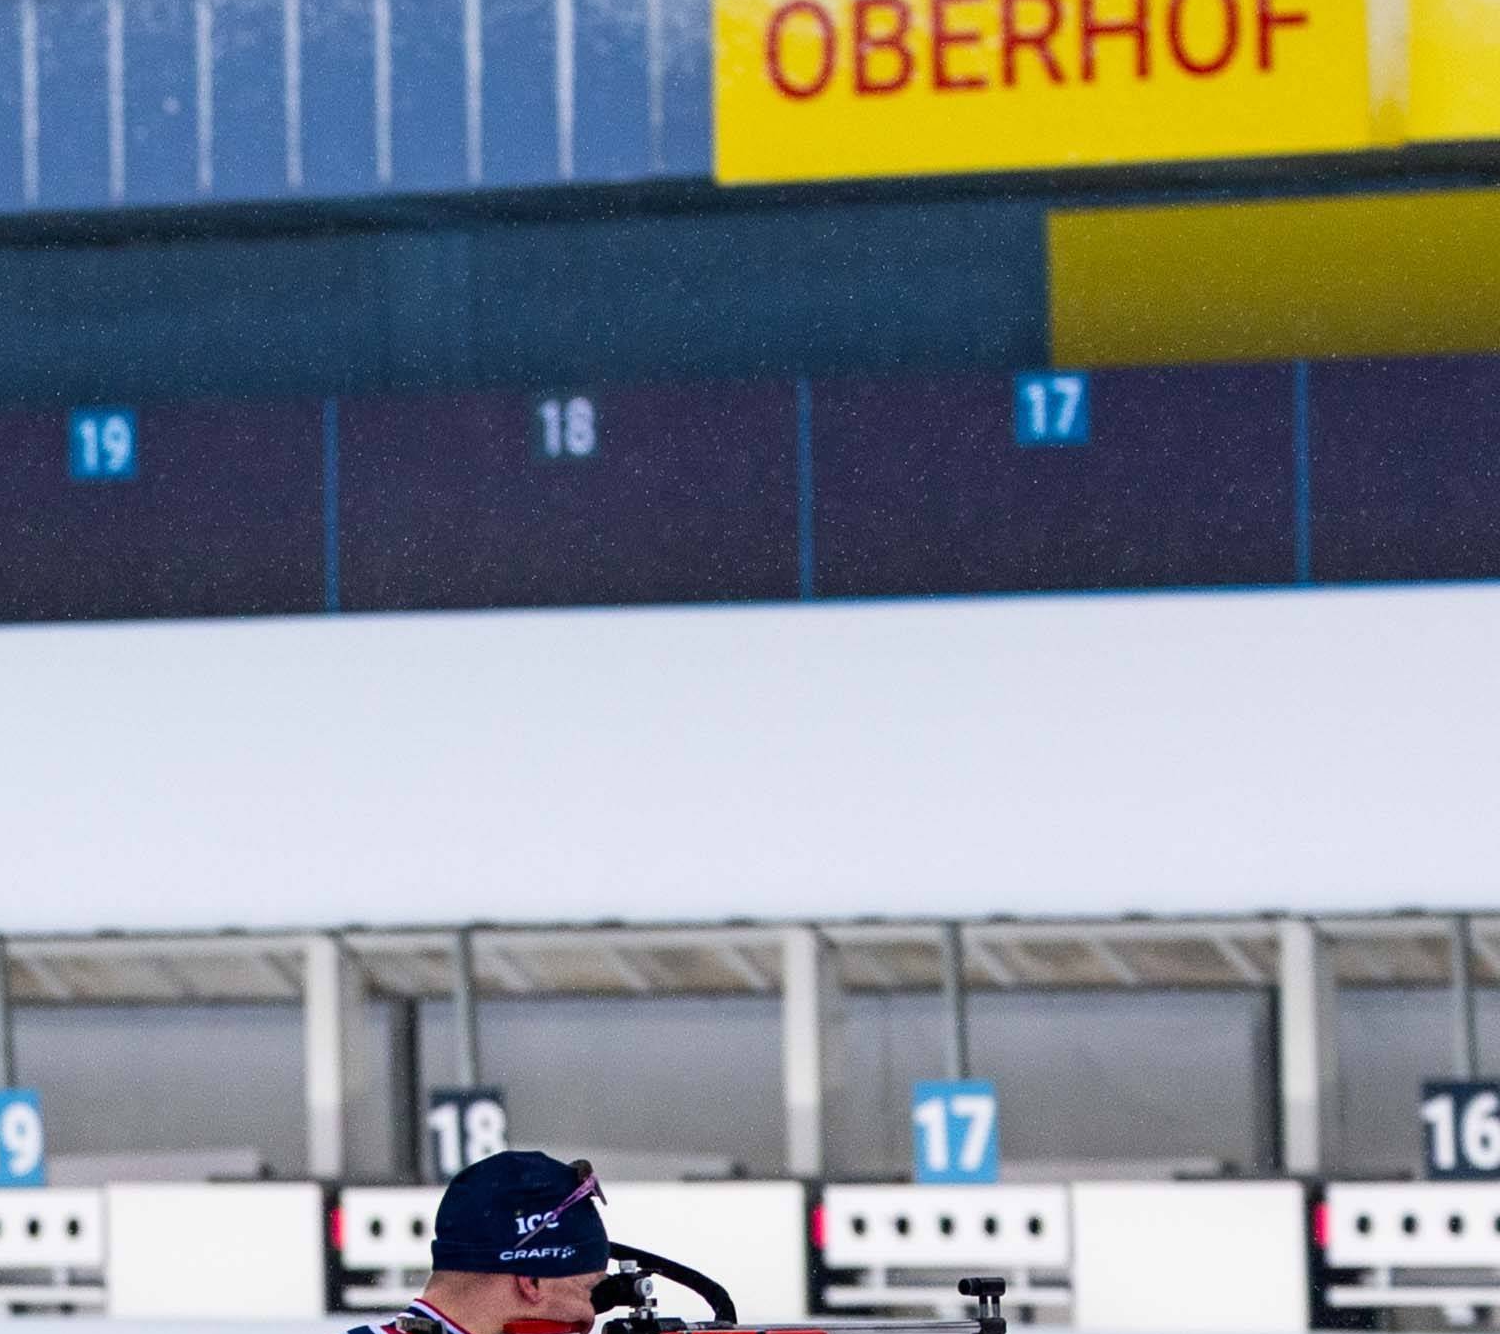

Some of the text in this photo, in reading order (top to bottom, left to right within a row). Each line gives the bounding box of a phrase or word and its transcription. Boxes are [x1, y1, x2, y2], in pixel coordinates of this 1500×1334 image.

[543, 396, 595, 458] 18
[1027, 377, 1082, 439] 17
[80, 415, 132, 469] 19
[428, 1100, 506, 1173] 18
[914, 1096, 997, 1172] 17
[1421, 1094, 1500, 1169] 16
[500, 1247, 561, 1260] CRAFT
